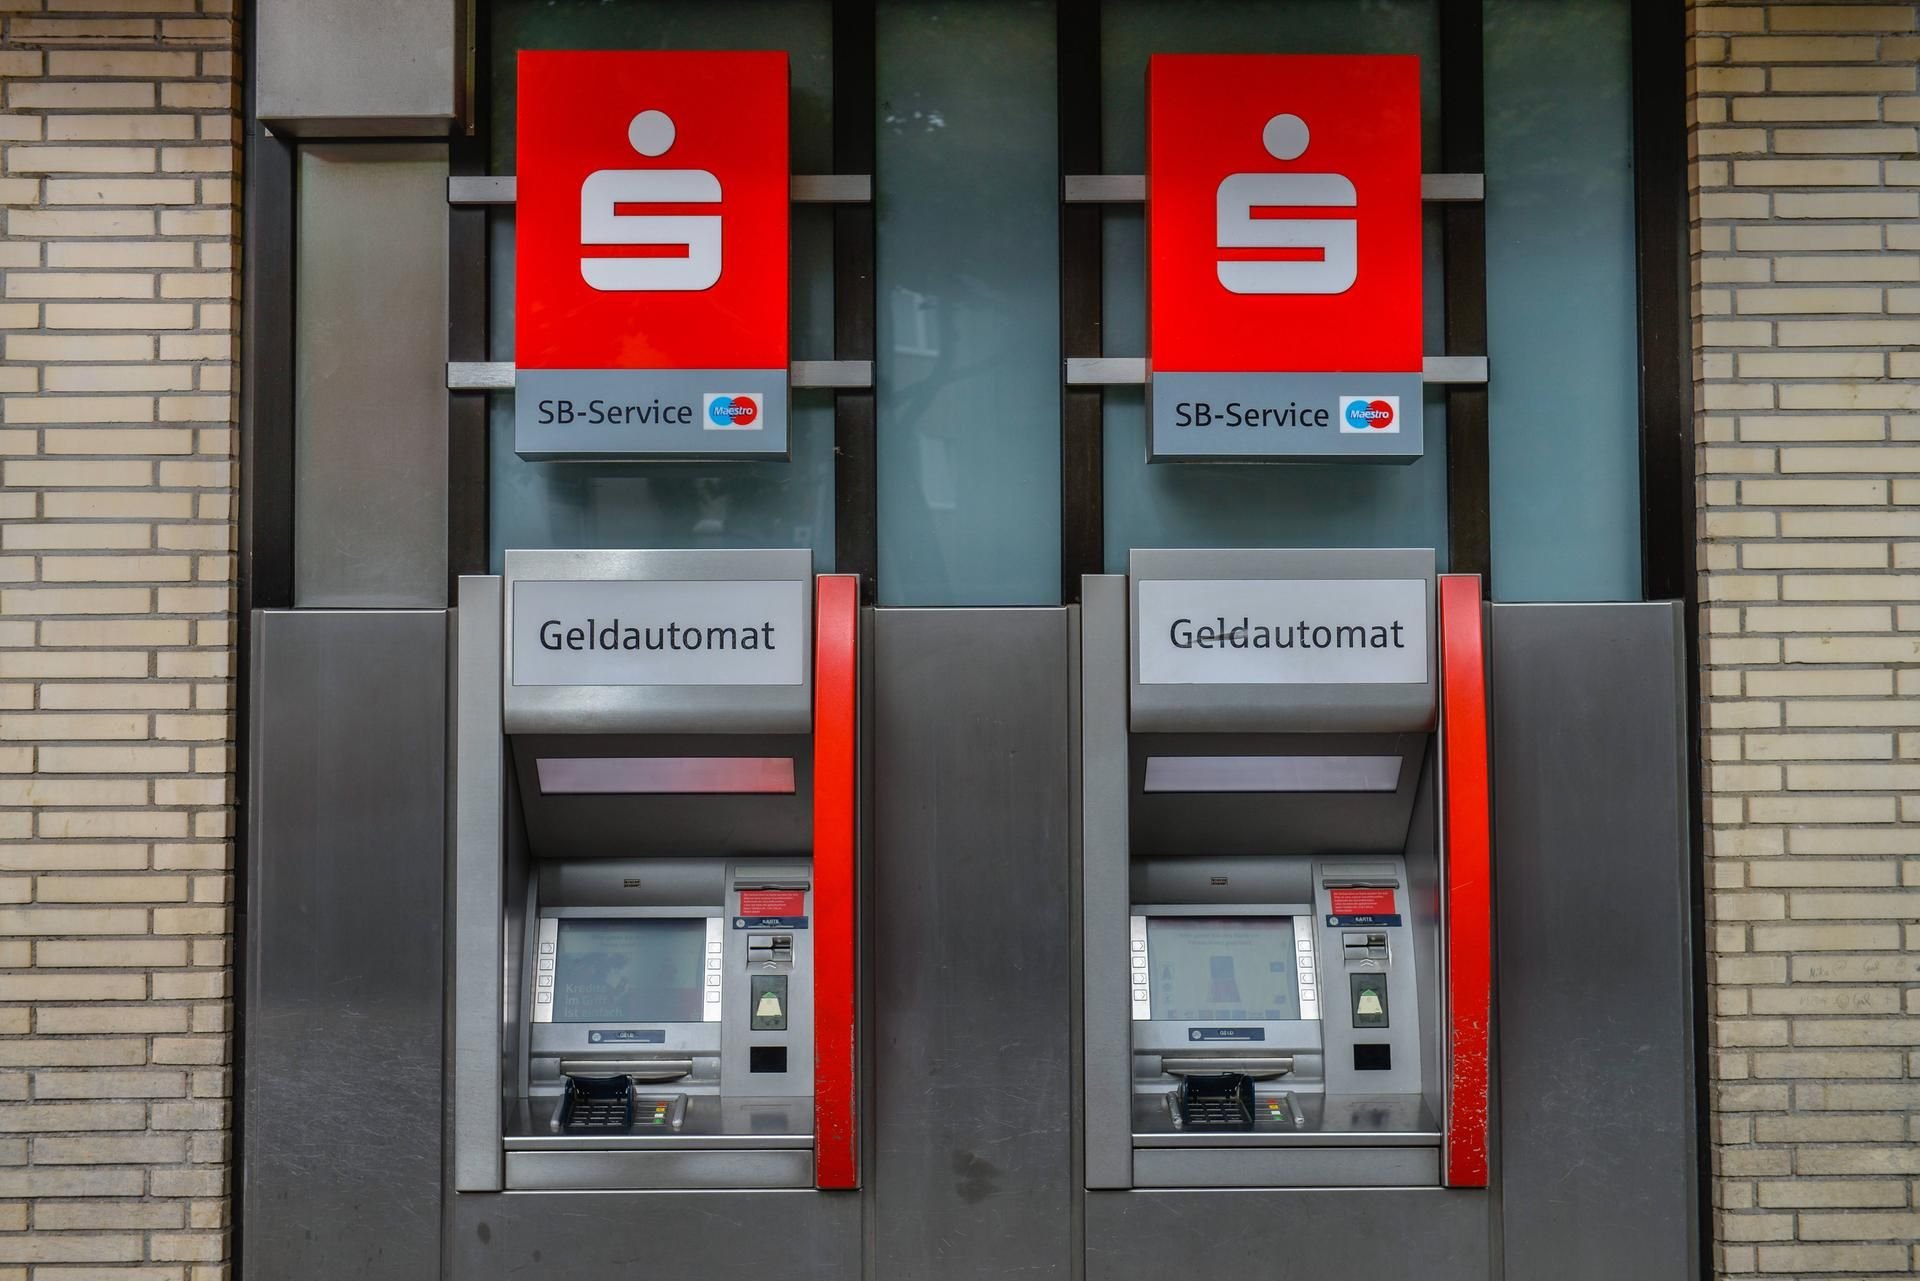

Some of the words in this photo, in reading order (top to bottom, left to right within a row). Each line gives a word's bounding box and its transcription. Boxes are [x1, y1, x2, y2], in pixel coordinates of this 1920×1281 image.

[538, 398, 693, 425] SB-Service
[713, 405, 754, 416] Maestro
[1175, 401, 1330, 428] SB-Service
[1350, 408, 1389, 420] Maestro
[539, 618, 776, 651] Geldautomat
[1170, 616, 1405, 649] Geldautomat
